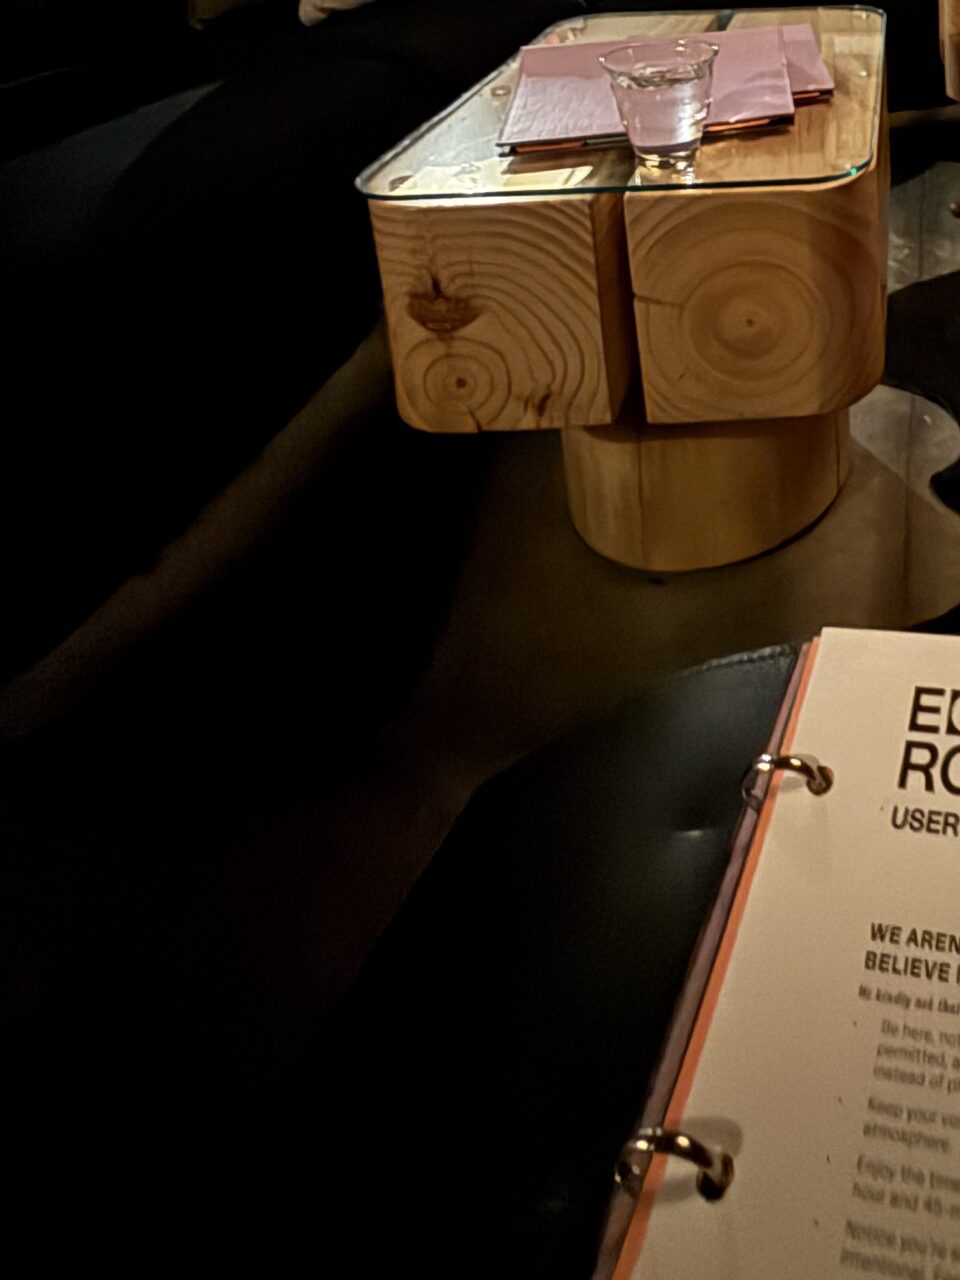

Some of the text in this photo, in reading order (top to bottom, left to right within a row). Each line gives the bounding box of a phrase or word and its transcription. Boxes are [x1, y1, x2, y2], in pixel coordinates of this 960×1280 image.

[891, 806, 960, 837] USER
[869, 922, 901, 945] WE
[864, 950, 951, 983] BELIEVE
